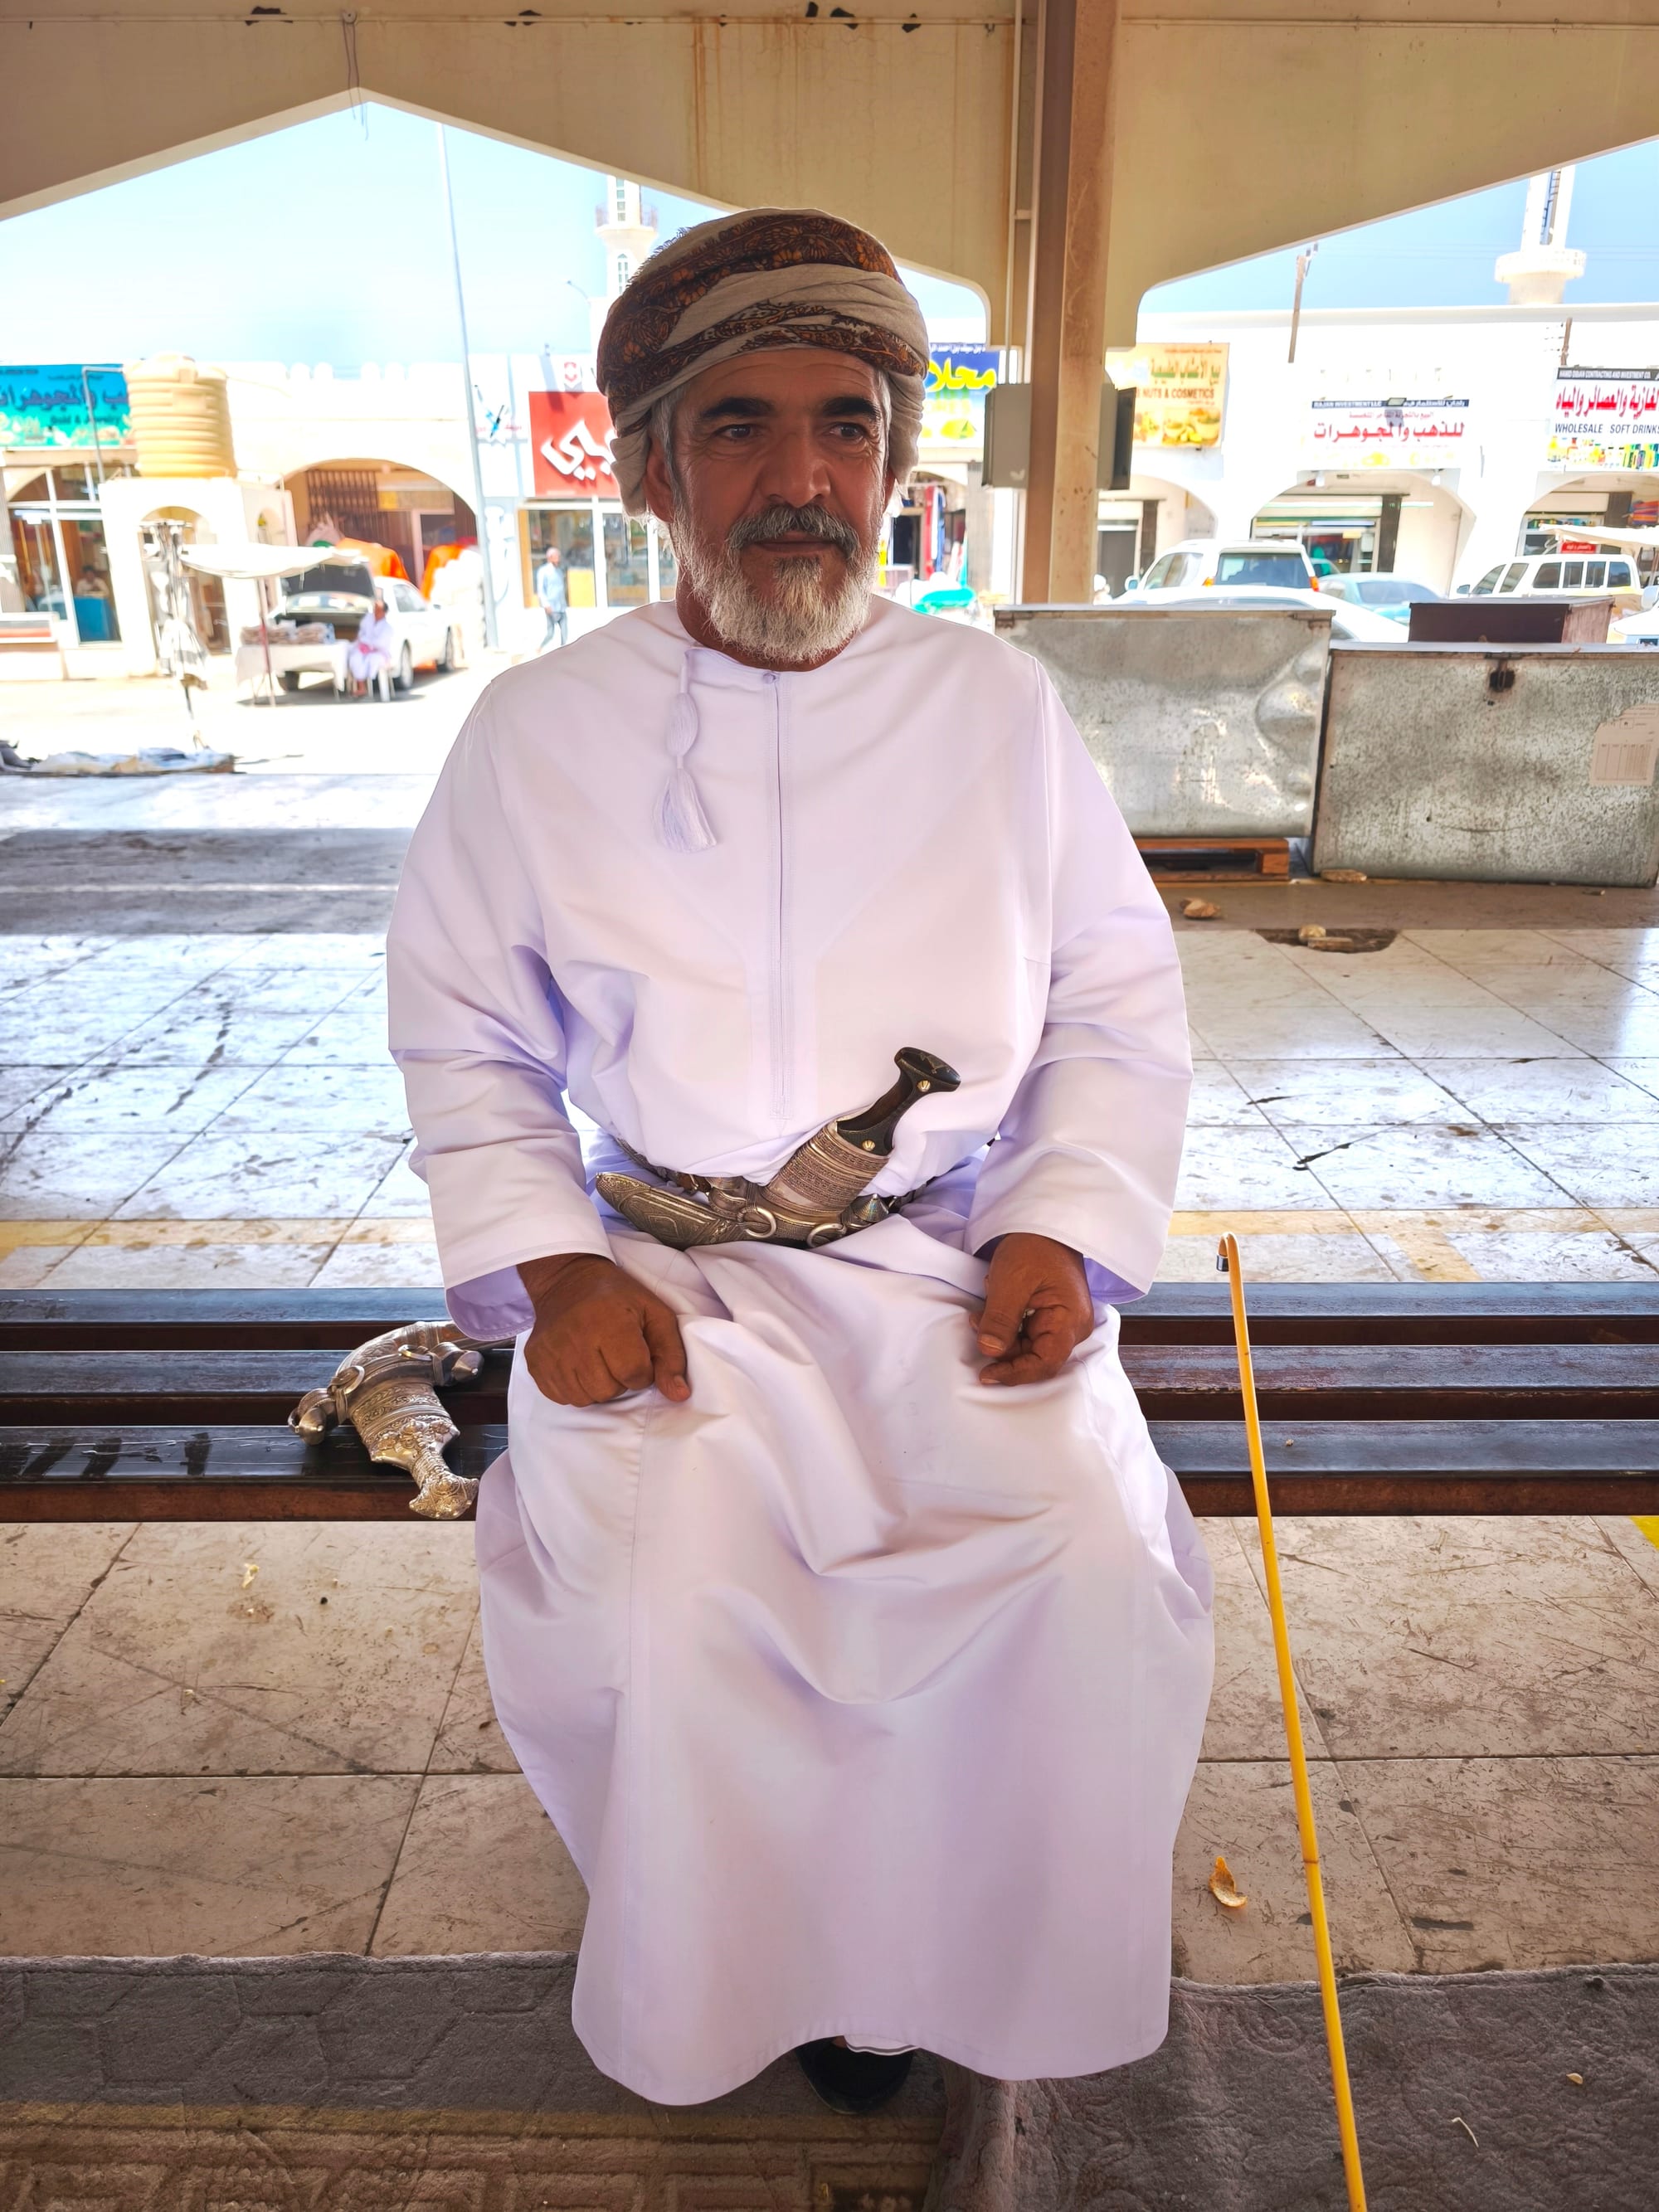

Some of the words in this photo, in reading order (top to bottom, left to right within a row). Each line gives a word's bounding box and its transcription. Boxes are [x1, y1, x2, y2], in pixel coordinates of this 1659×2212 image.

[1142, 387, 1162, 399] NUTS
[1164, 387, 1170, 399] &
[1171, 387, 1215, 399] COSMETICS
[1314, 422, 1410, 443] والمجوهرات
[1413, 421, 1465, 442] للذهب
[1554, 423, 1603, 434] WHOLESALE
[1609, 424, 1631, 434] SOFT
